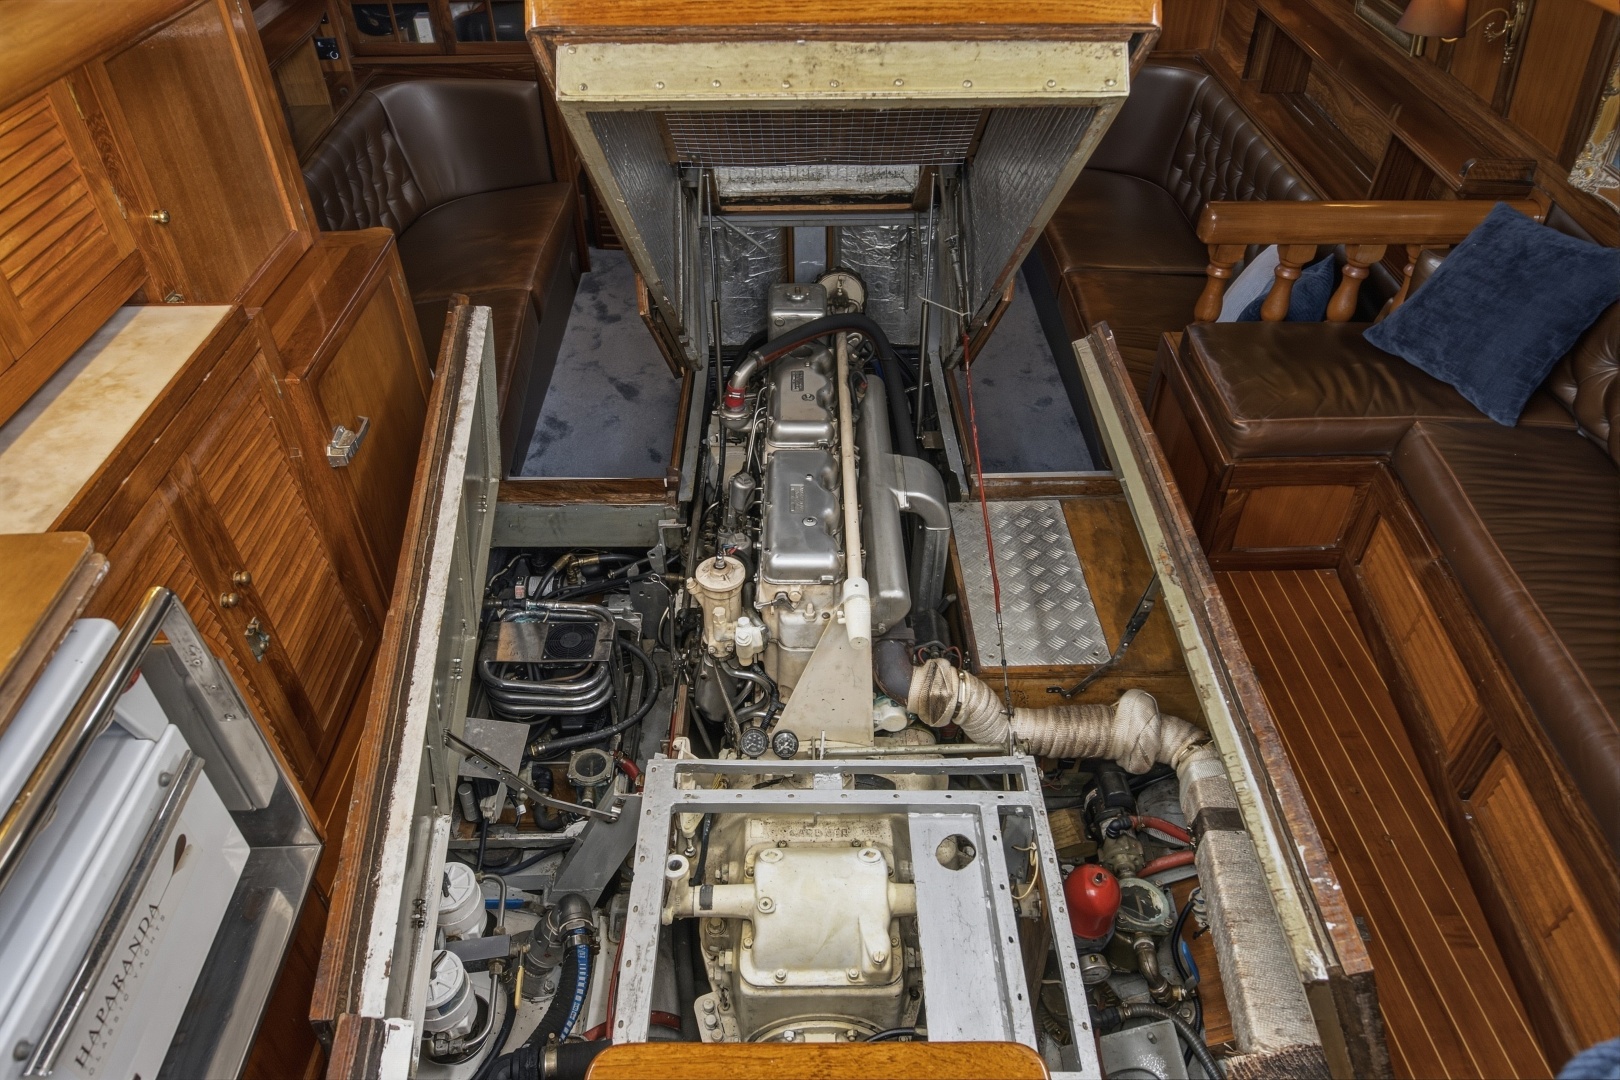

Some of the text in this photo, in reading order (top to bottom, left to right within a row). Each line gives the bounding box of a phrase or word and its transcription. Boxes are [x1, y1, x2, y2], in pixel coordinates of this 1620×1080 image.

[75, 903, 159, 1069] HAPARANDA
[89, 915, 166, 1076] CLASSIC YACHTS
